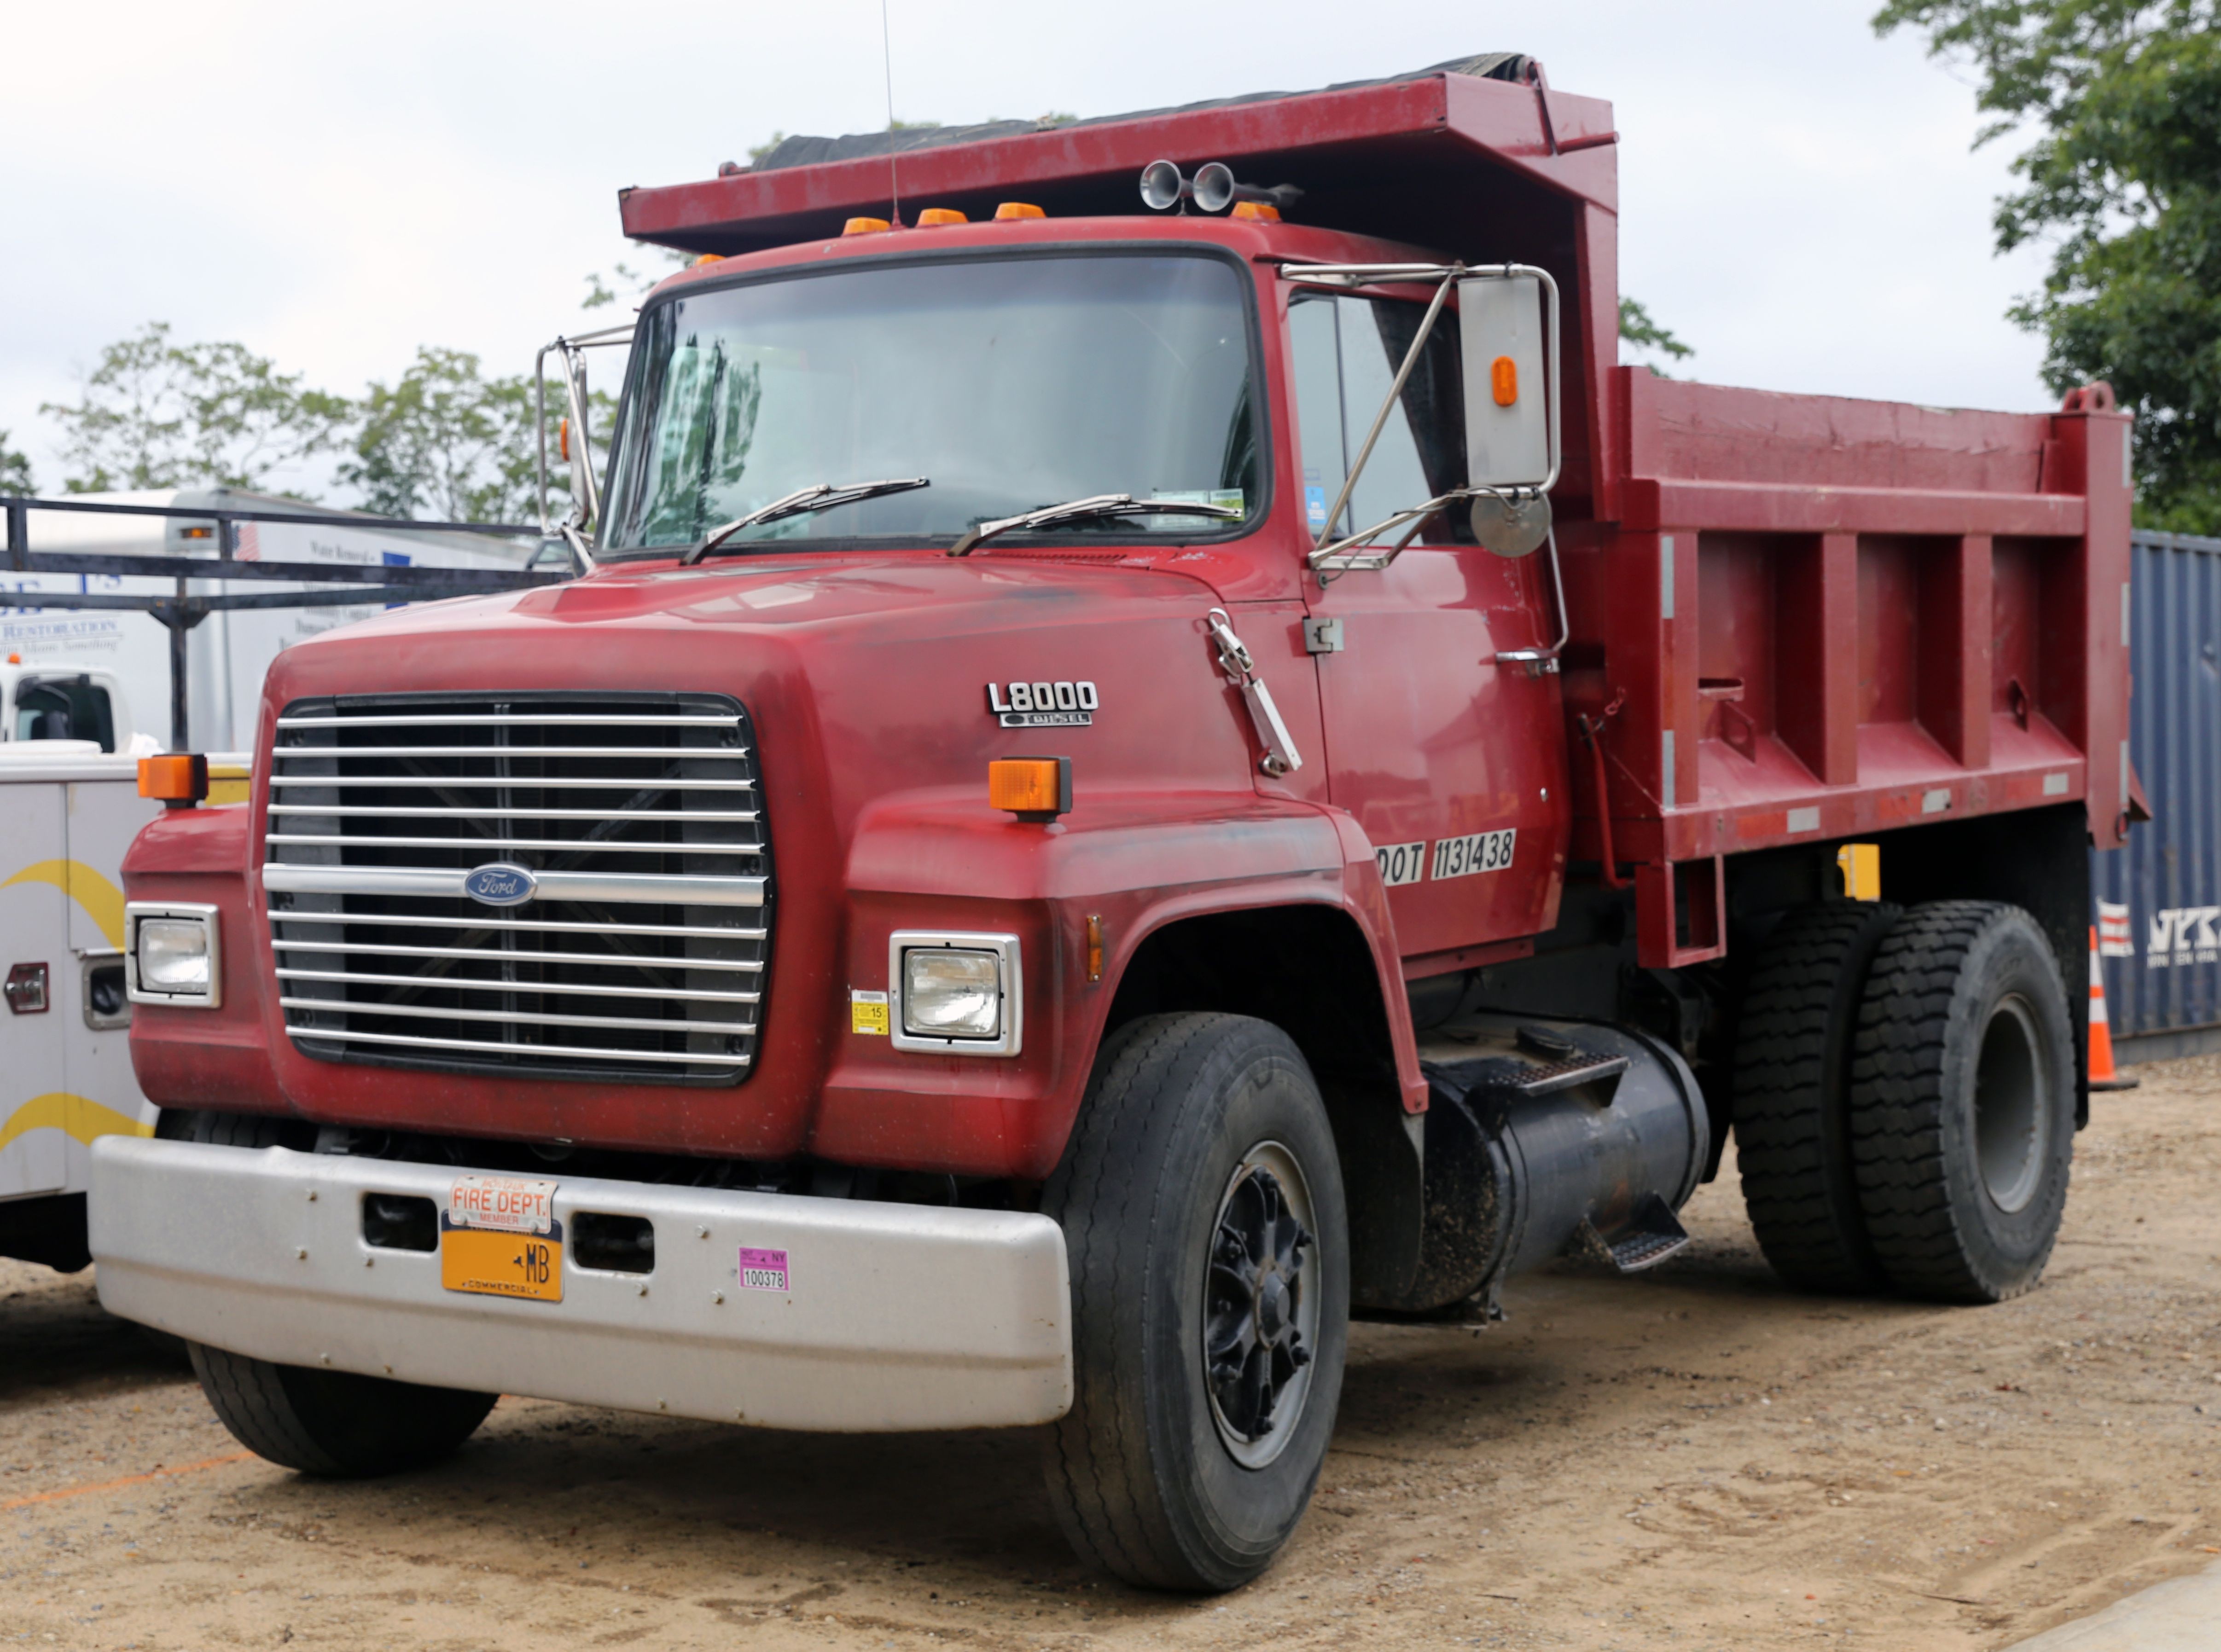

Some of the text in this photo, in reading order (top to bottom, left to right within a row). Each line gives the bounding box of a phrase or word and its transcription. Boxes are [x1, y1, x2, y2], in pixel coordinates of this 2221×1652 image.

[987, 680, 1099, 713] L8000
[1435, 832, 1513, 877] 1131438
[478, 872, 517, 894] Ford
[872, 1007, 882, 1018] 15
[454, 1188, 546, 1216] FIRE DEPT.
[479, 1213, 519, 1224] MEMBER
[526, 1244, 549, 1283] MB
[772, 1253, 785, 1262] NY
[468, 1280, 533, 1293] COMMERCIAL
[745, 1270, 784, 1287] 100378
